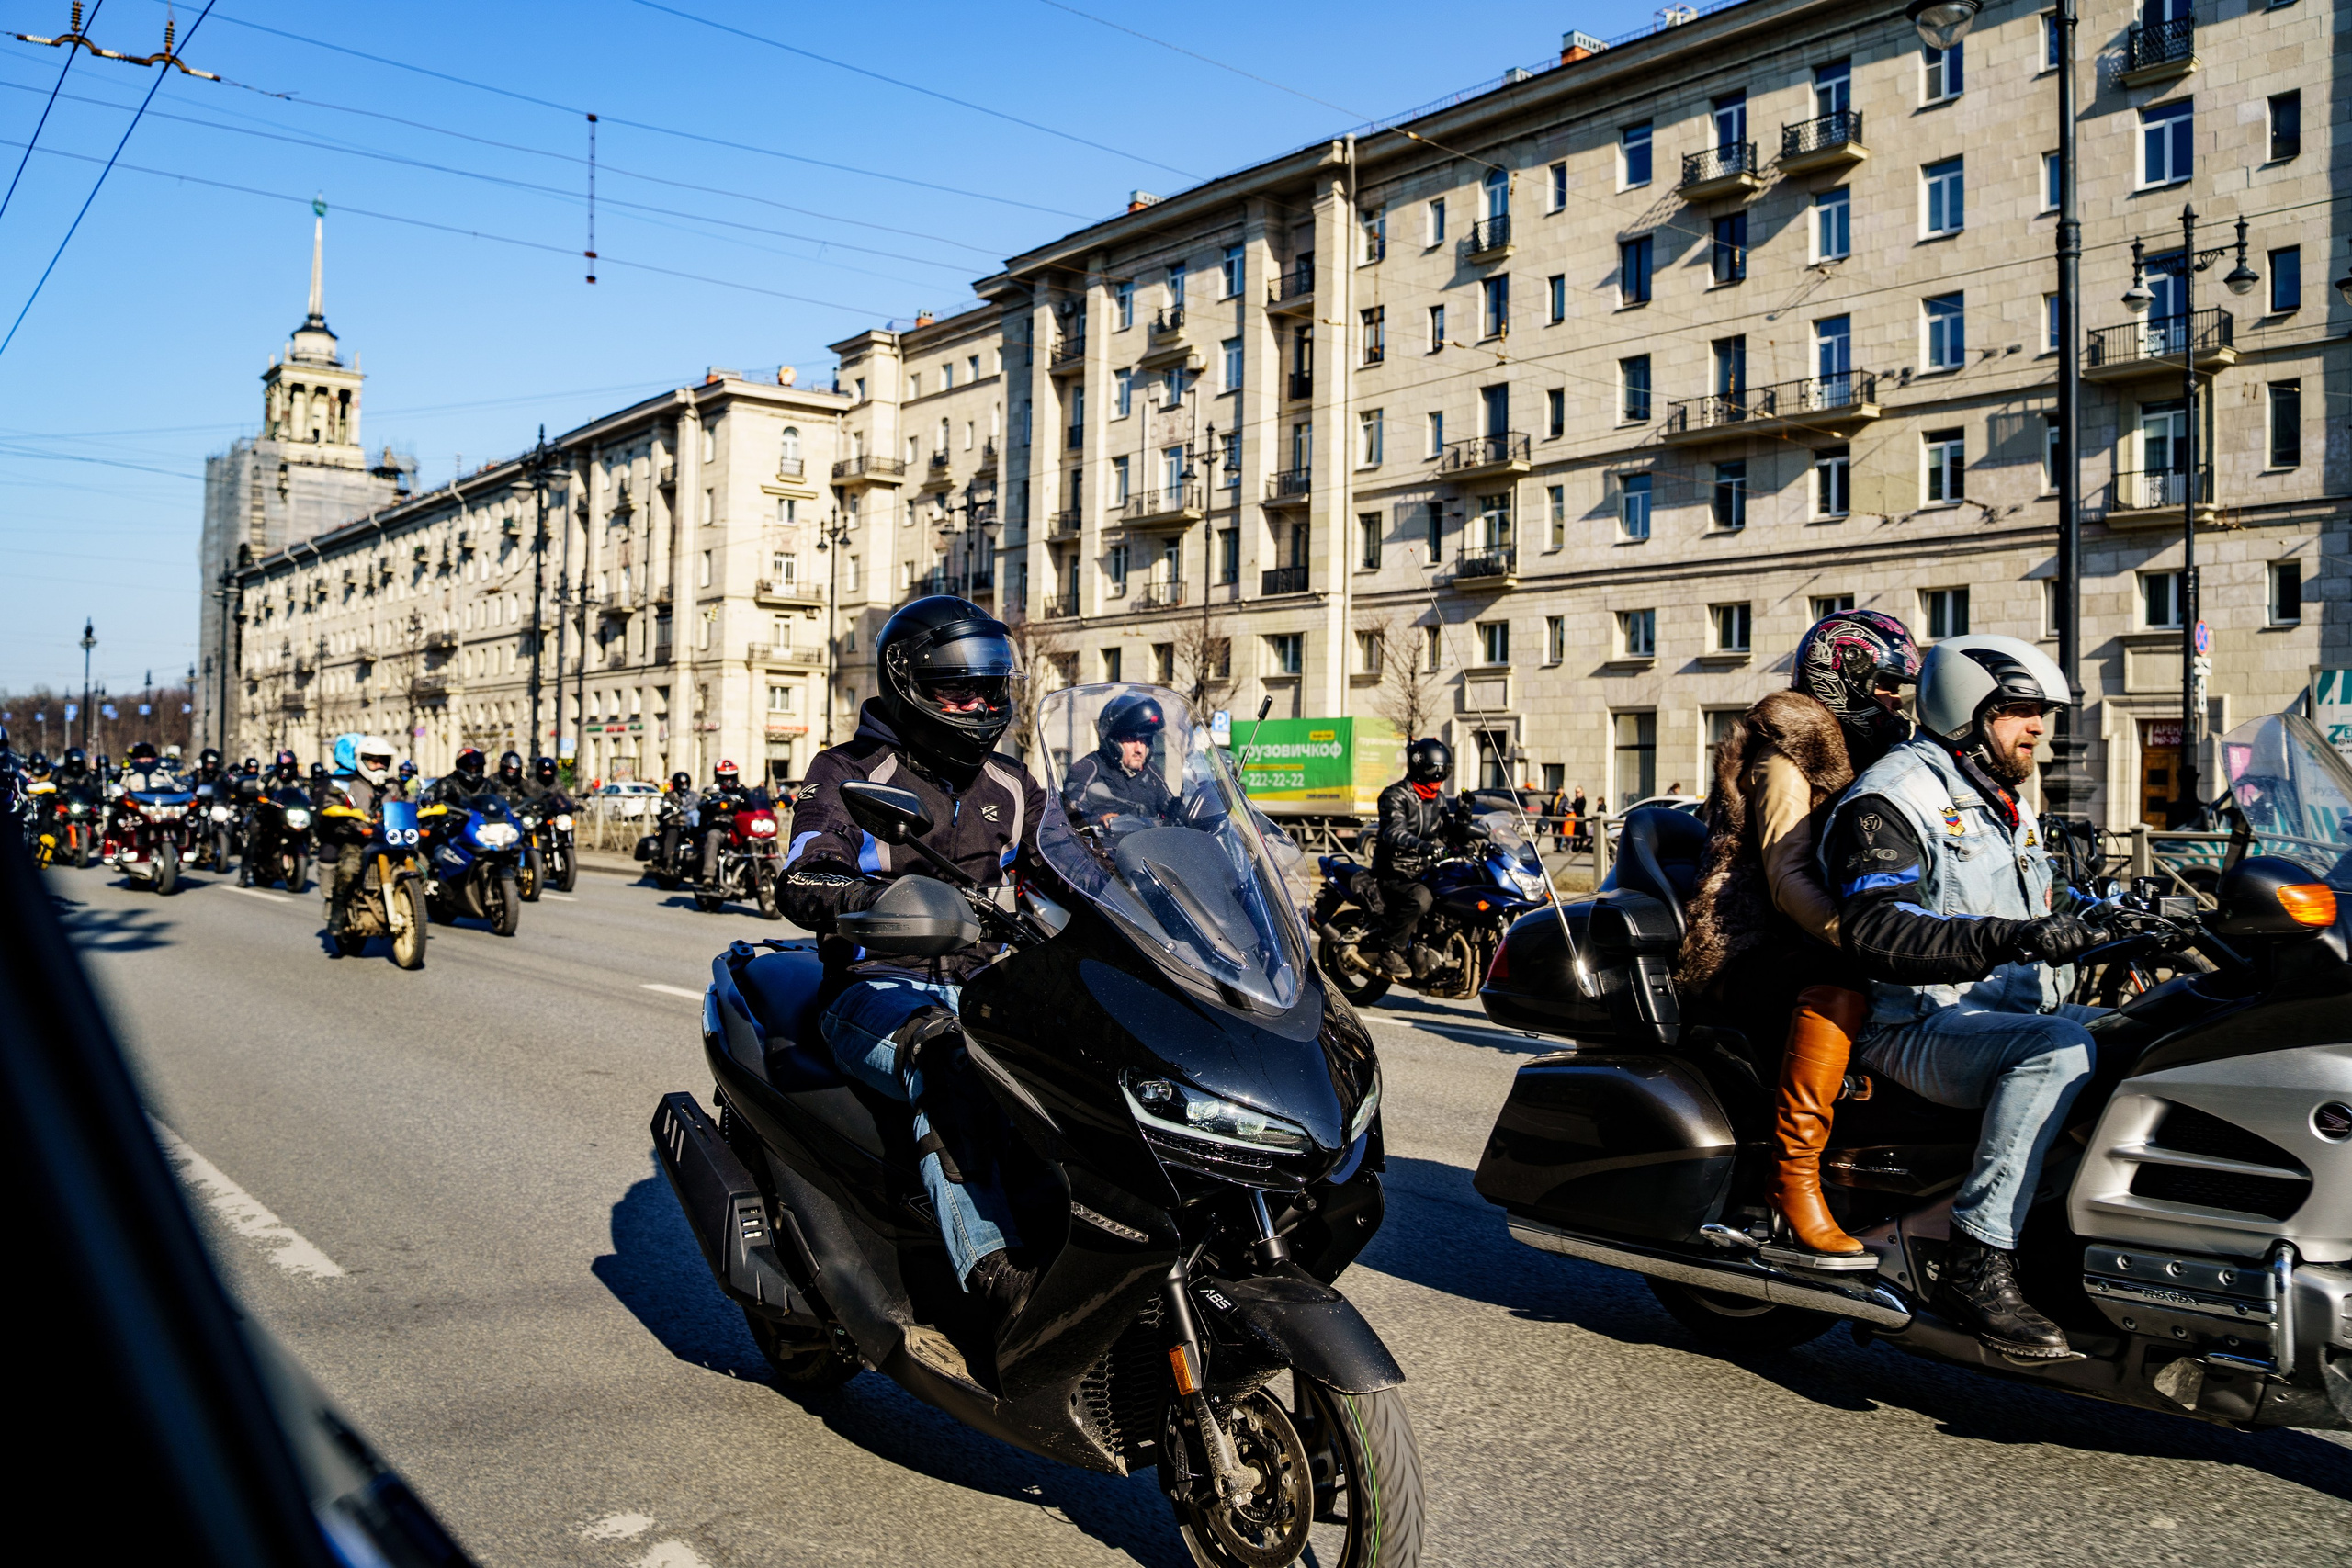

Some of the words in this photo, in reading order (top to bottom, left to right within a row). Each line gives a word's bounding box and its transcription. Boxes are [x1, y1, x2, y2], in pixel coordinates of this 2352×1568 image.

[1215, 712, 1226, 730] P
[2327, 724, 2352, 744] ZE
[1249, 773, 1305, 787] 222-22-22
[1199, 1289, 1231, 1309] ABS
